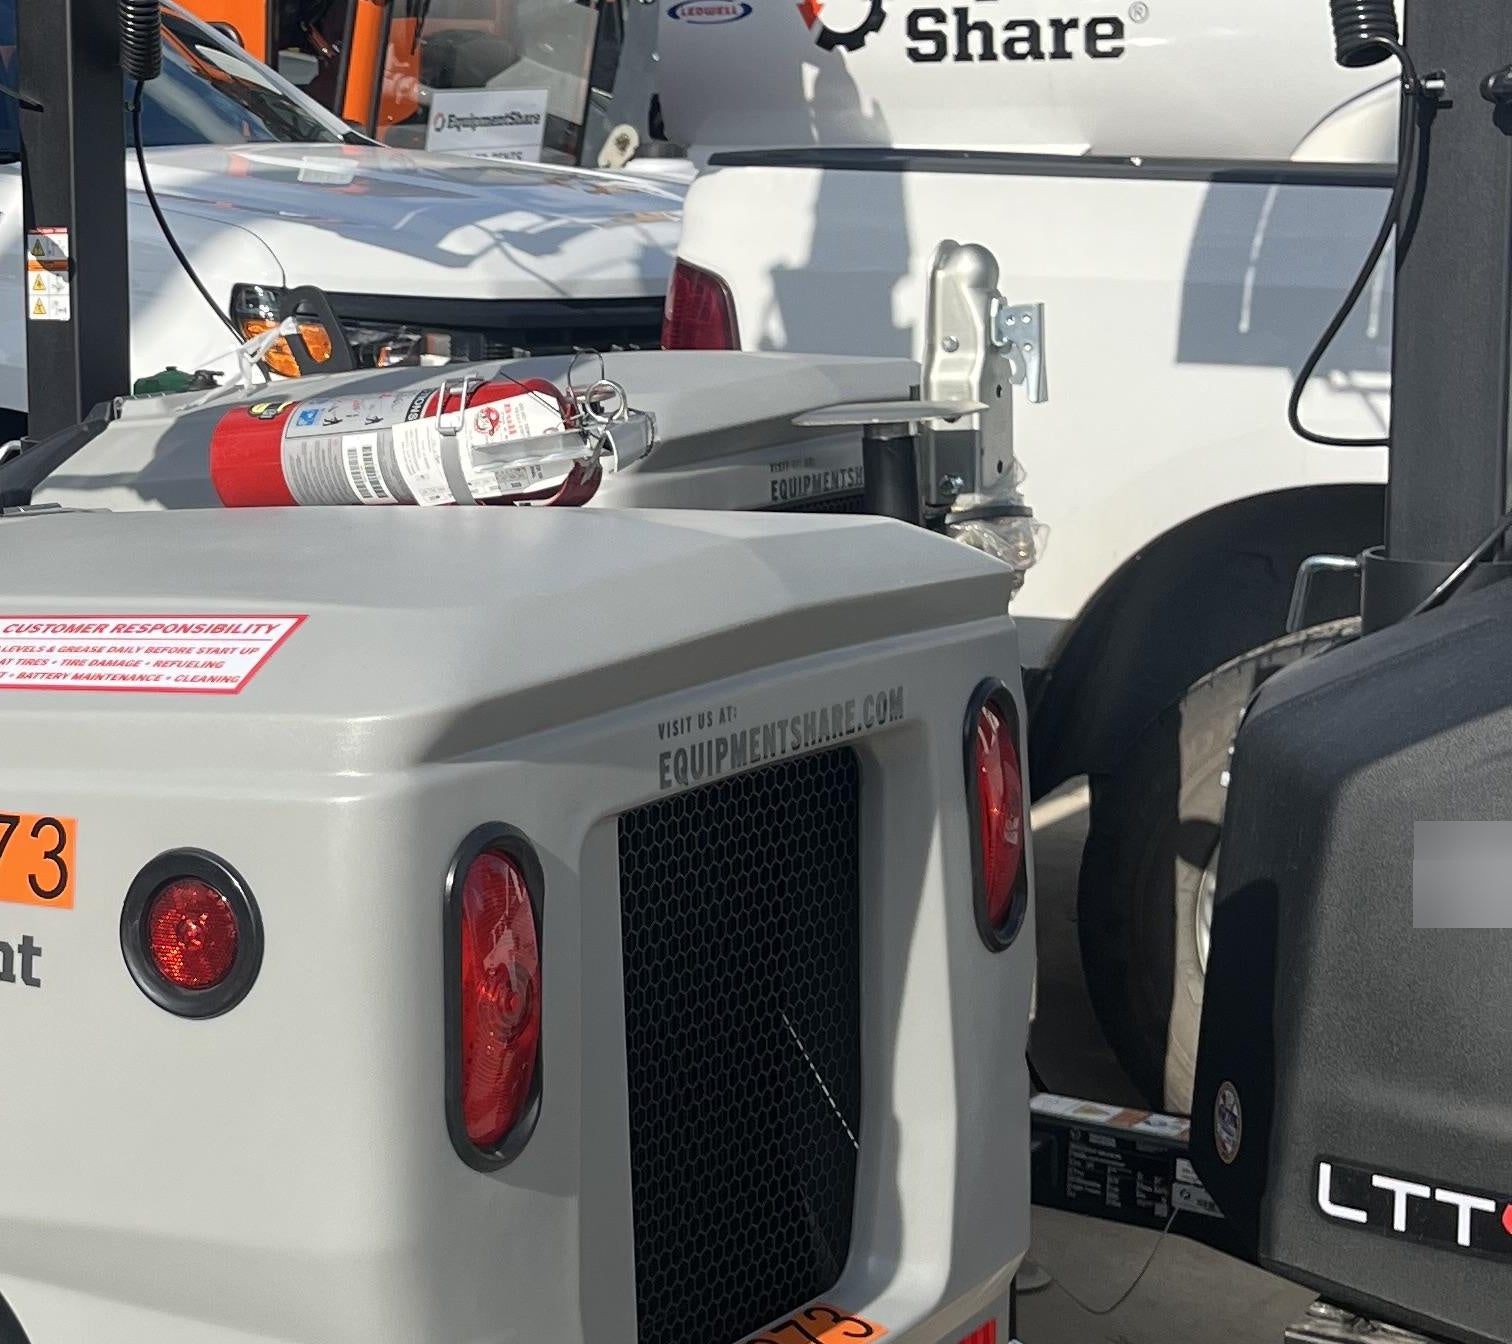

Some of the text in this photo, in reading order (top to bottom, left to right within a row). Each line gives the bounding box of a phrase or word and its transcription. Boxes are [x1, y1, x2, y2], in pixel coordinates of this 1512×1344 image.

[2, 623, 110, 634] CUSTOMER
[110, 623, 281, 635] RESPONSIBILITY
[1, 645, 44, 653] LEVELS
[57, 645, 105, 654] GREASE
[107, 646, 145, 654] DAILY
[145, 647, 194, 655] BEFORE
[197, 647, 239, 655] START
[240, 647, 261, 655] UP
[15, 658, 50, 666] TIRES
[61, 659, 86, 667] TIRE
[87, 659, 146, 668] DAMAGE
[152, 660, 226, 669] REFUELING
[16, 672, 69, 680] BATTERY
[70, 673, 164, 682] MAINTENANCE
[173, 674, 241, 683] CLEANING
[658, 705, 737, 740] VISIT US AT:
[659, 686, 905, 790] EQUIPMENTSHARE.COM
[1318, 1161, 1512, 1247] LTT
